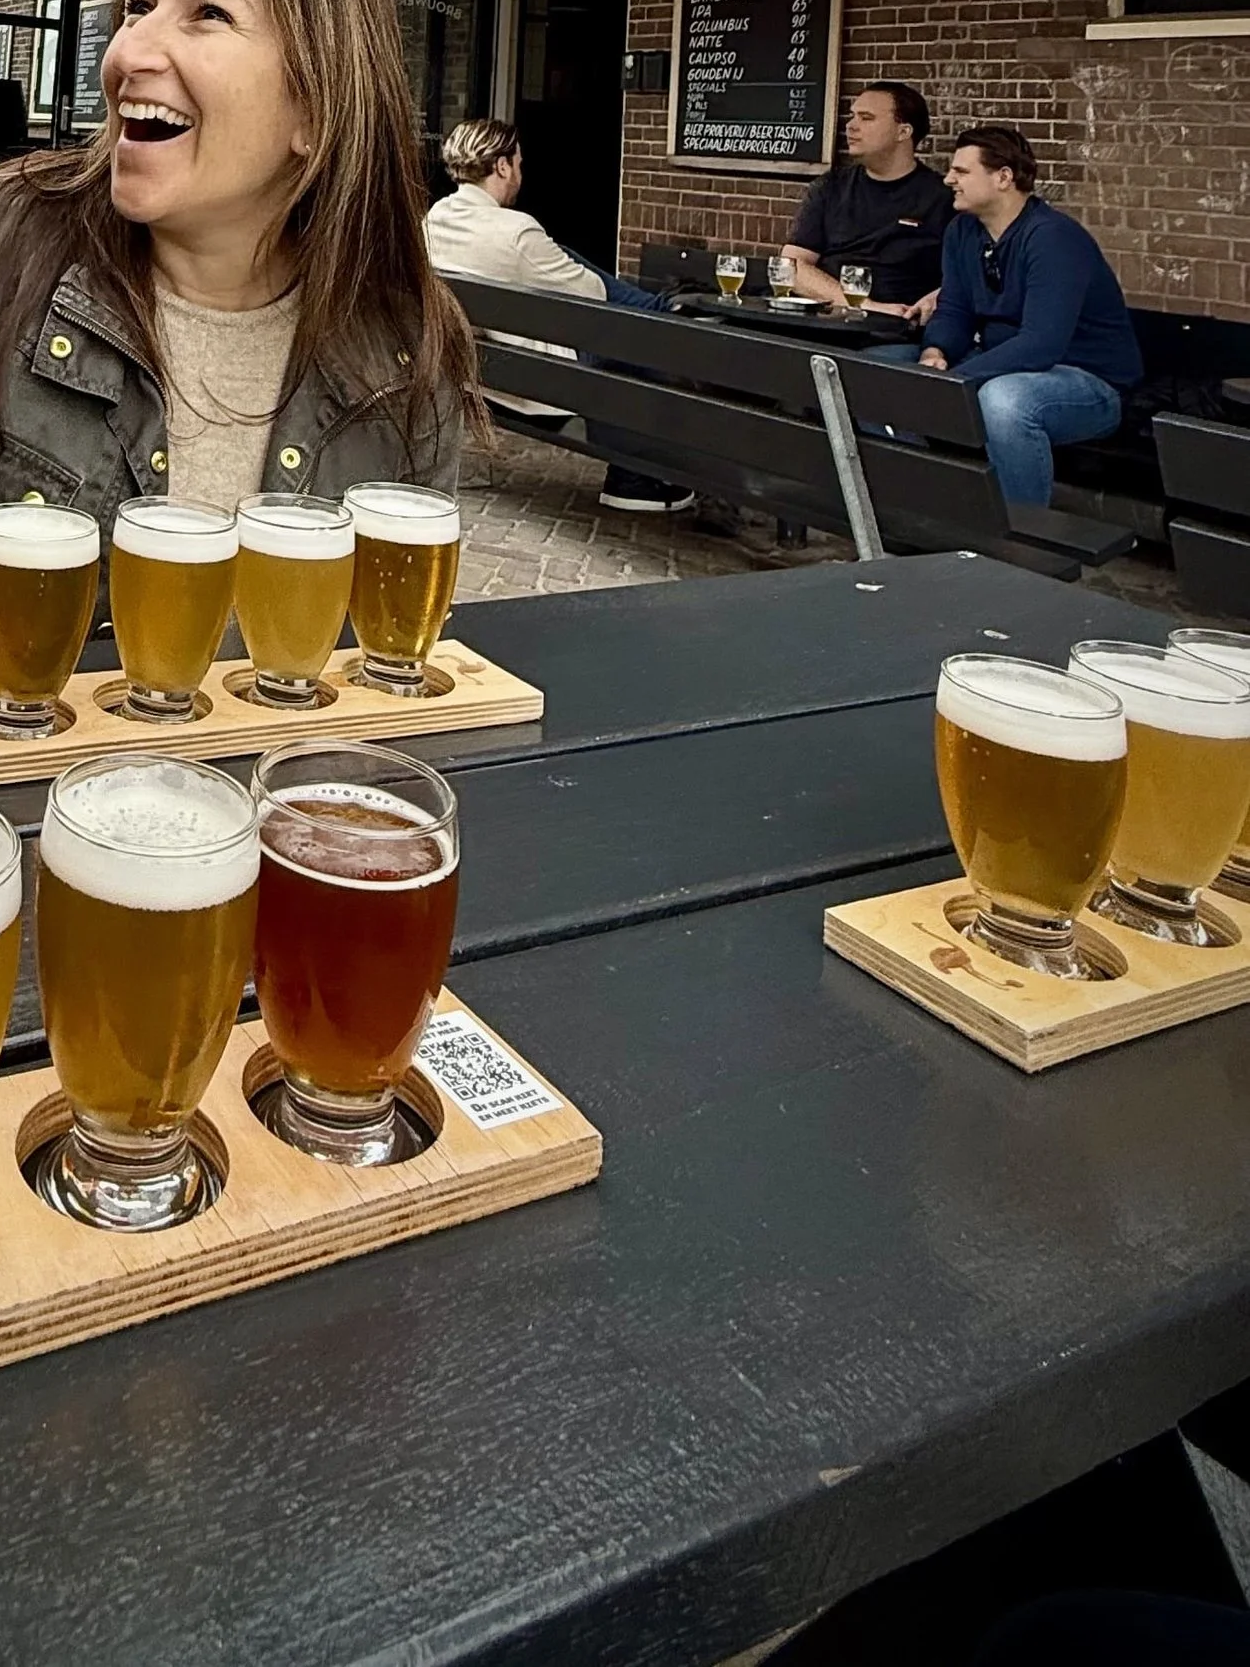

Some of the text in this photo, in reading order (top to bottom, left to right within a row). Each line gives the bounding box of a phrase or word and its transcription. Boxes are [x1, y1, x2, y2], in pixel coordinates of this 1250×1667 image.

[691, 4, 712, 19] IPA
[689, 17, 750, 34] COLUMBUS
[688, 34, 724, 49] NATTE
[688, 51, 737, 65] CALYPSO
[687, 66, 732, 81] GOUDEN
[733, 66, 745, 81] IJ
[687, 82, 727, 93] SPECIALS
[774, 126, 815, 141] TASTING
[683, 137, 797, 155] SPECIAALBIERPROEVERIJ
